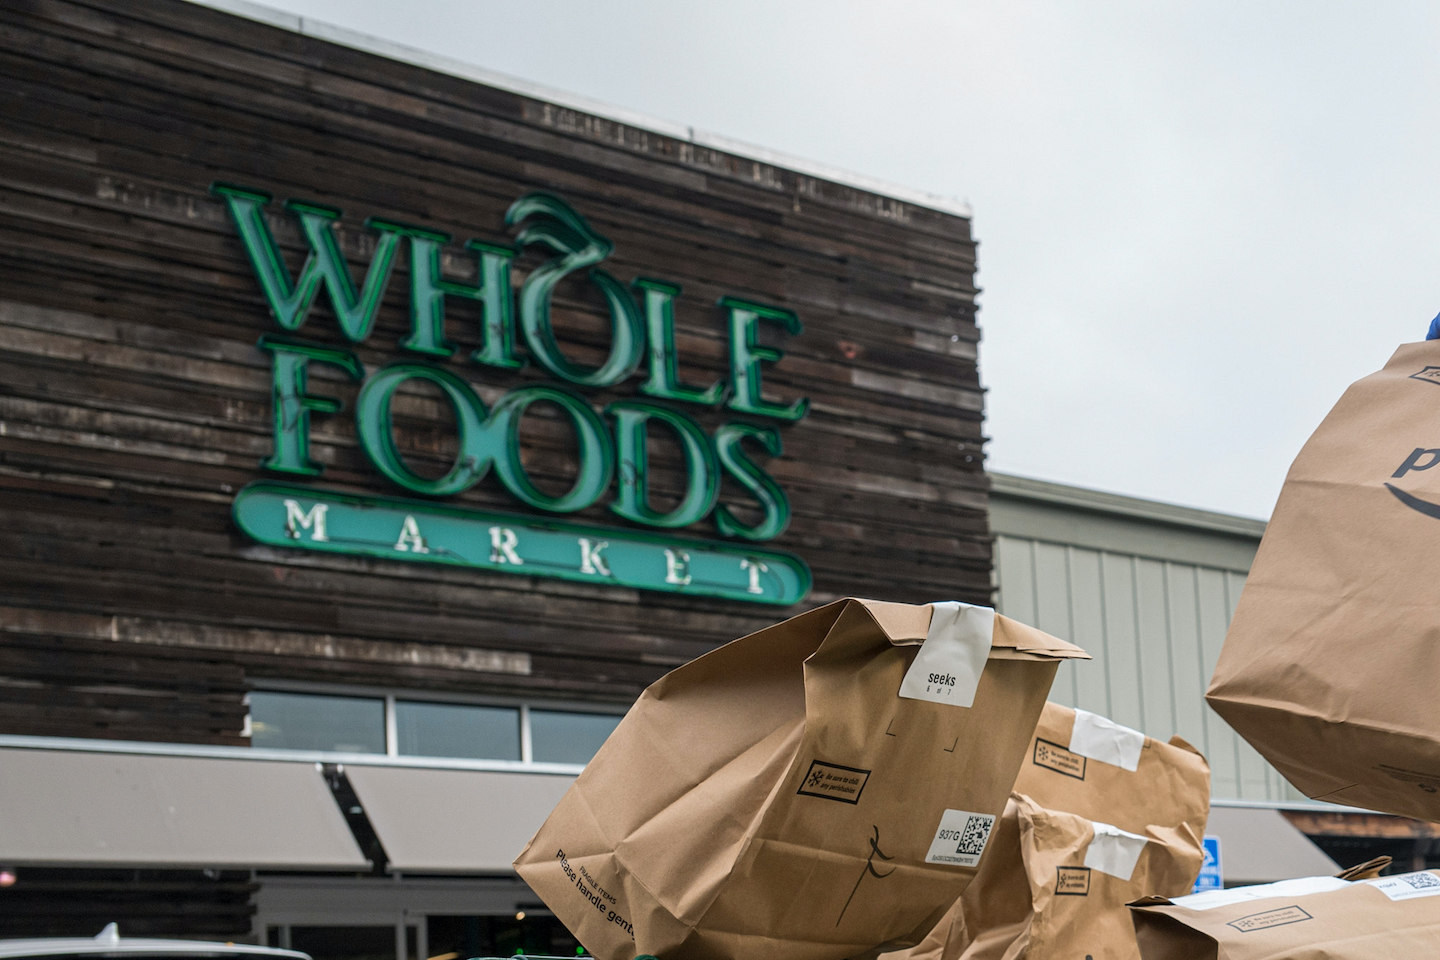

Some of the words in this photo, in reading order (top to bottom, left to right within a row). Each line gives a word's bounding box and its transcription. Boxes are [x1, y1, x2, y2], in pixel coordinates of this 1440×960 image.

[208, 181, 811, 421] WHOLE
[258, 333, 791, 541] FOODS
[284, 499, 769, 595] MARKET
[928, 672, 956, 687] seeks
[938, 829, 960, 841] 937G
[556, 849, 576, 882] Please
[576, 877, 606, 913] handle
[579, 865, 599, 890] FRAGILE
[598, 887, 616, 905] ITEMS
